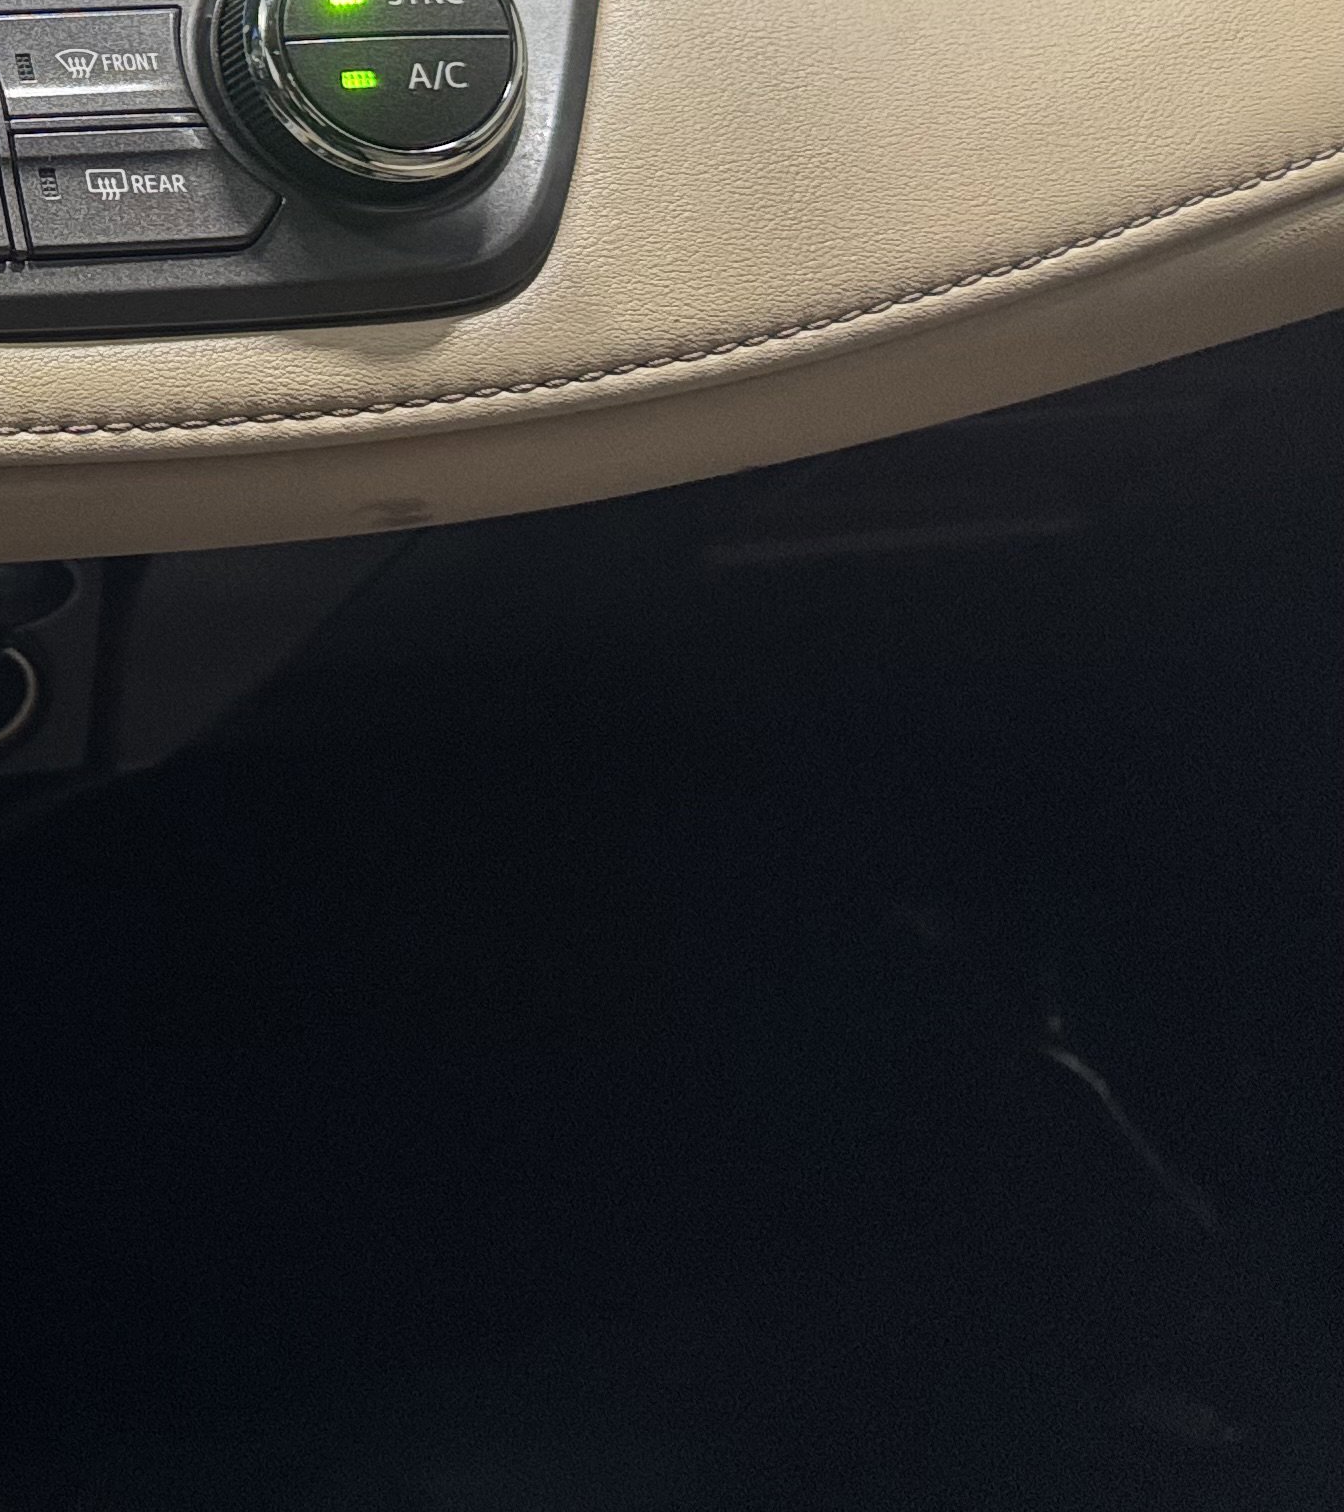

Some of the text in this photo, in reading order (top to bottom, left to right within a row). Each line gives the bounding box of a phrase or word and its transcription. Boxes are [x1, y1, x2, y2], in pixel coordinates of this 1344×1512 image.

[101, 52, 160, 72] FRONT
[407, 62, 471, 91] A/C
[130, 174, 189, 195] REAR
